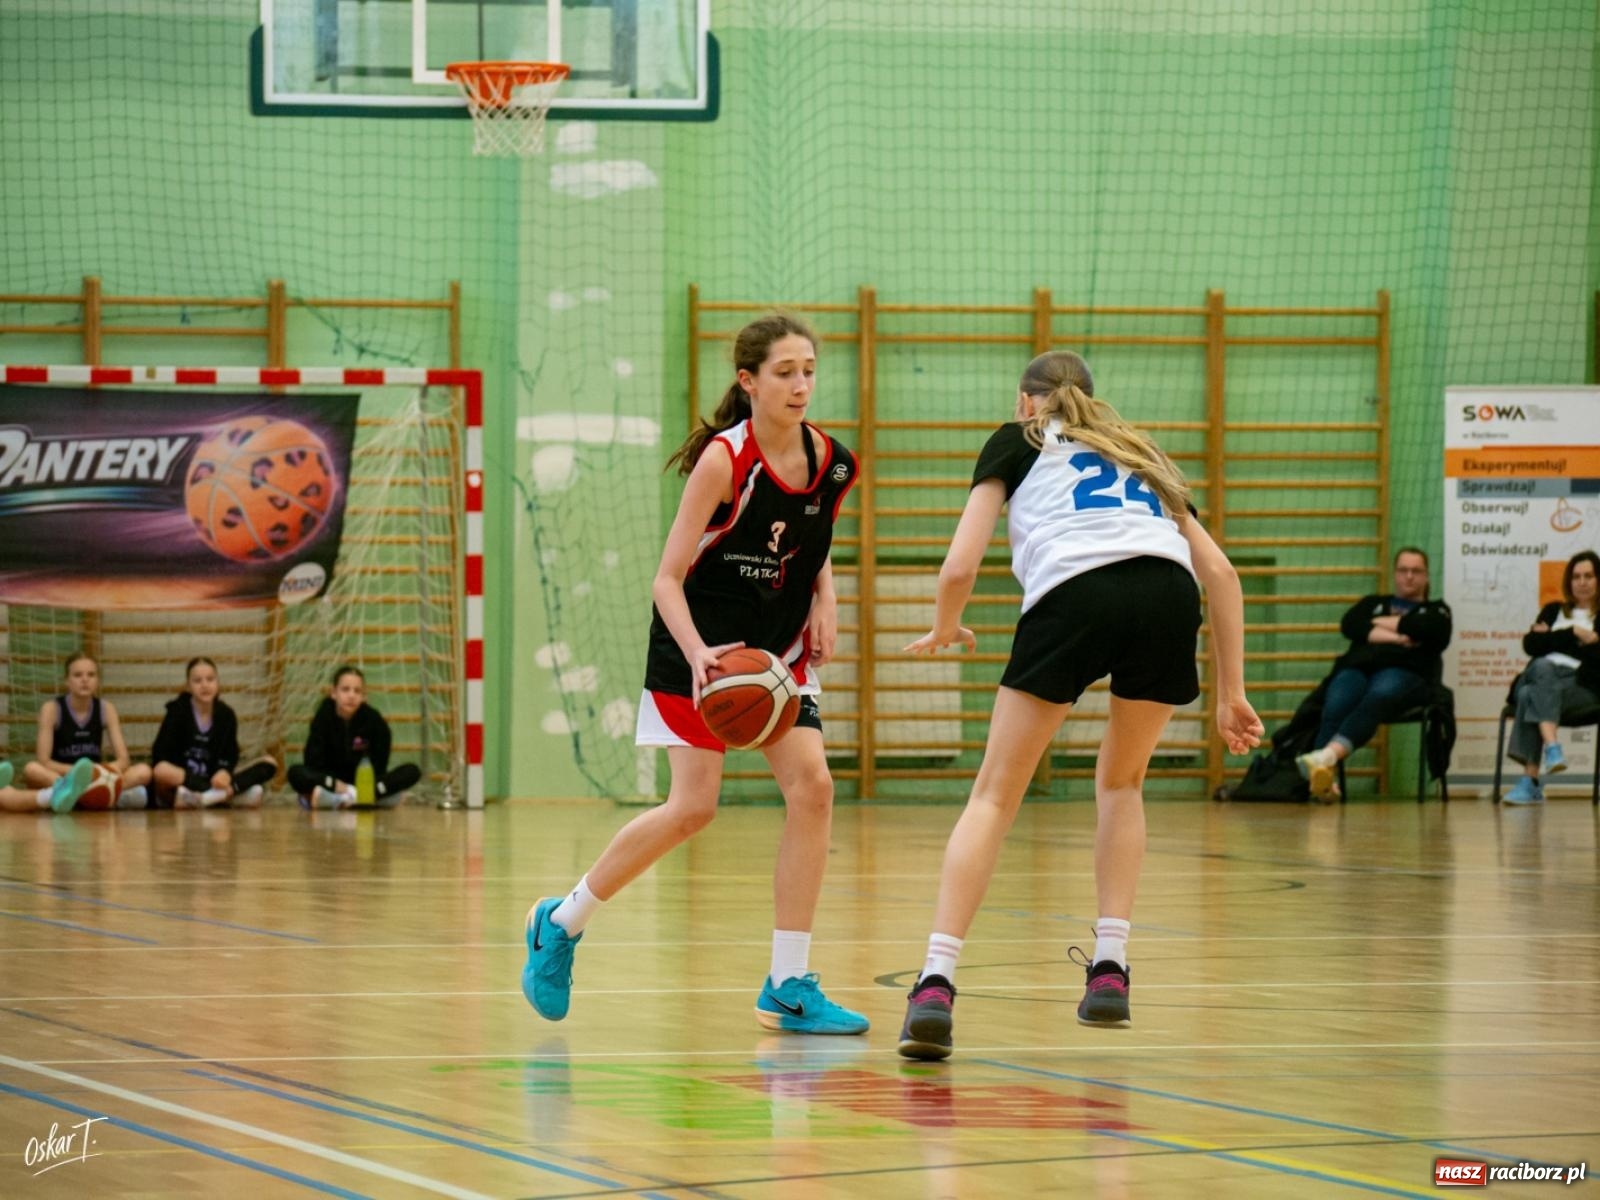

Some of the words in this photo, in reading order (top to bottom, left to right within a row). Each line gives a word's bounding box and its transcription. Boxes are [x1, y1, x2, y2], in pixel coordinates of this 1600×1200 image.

[1462, 405, 1526, 422] SOWA
[1463, 458, 1567, 474] Eksperymentuj!
[1462, 480, 1536, 494] Sprawdzaj!
[1462, 501, 1529, 515] Obserwuj!
[1462, 522, 1511, 536] Działaj!
[1461, 542, 1549, 557] Doświadczaj!
